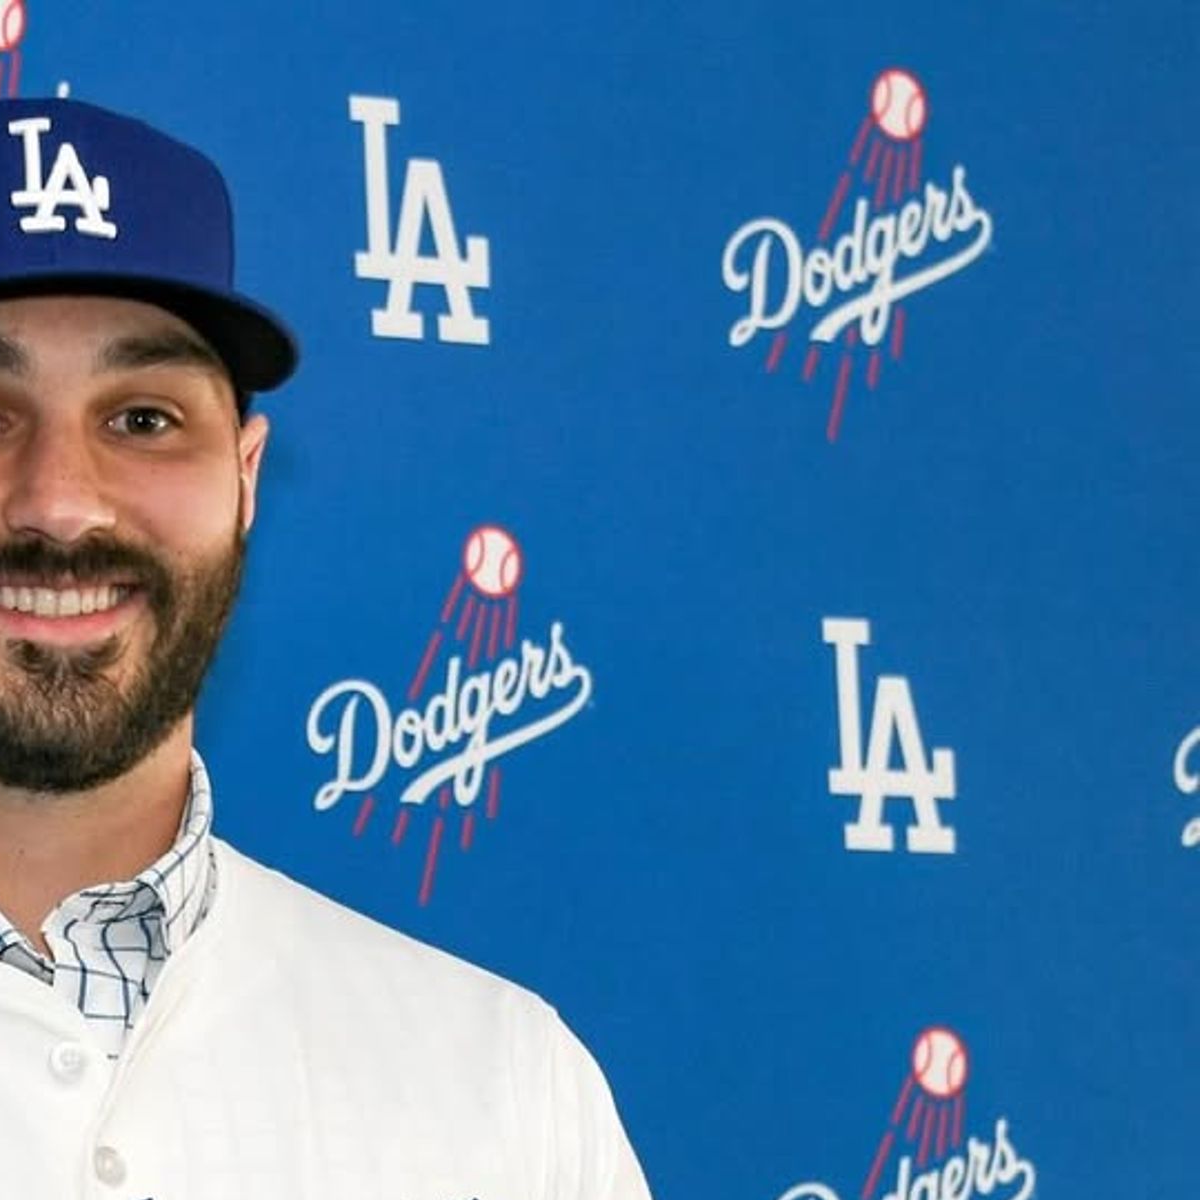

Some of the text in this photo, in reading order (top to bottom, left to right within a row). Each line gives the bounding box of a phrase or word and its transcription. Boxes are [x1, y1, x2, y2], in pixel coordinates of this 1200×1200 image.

[7, 117, 117, 239] LA
[349, 94, 491, 345] LA
[722, 166, 993, 346] Dodgers
[306, 622, 592, 811] Dodgers
[822, 617, 957, 855] LA
